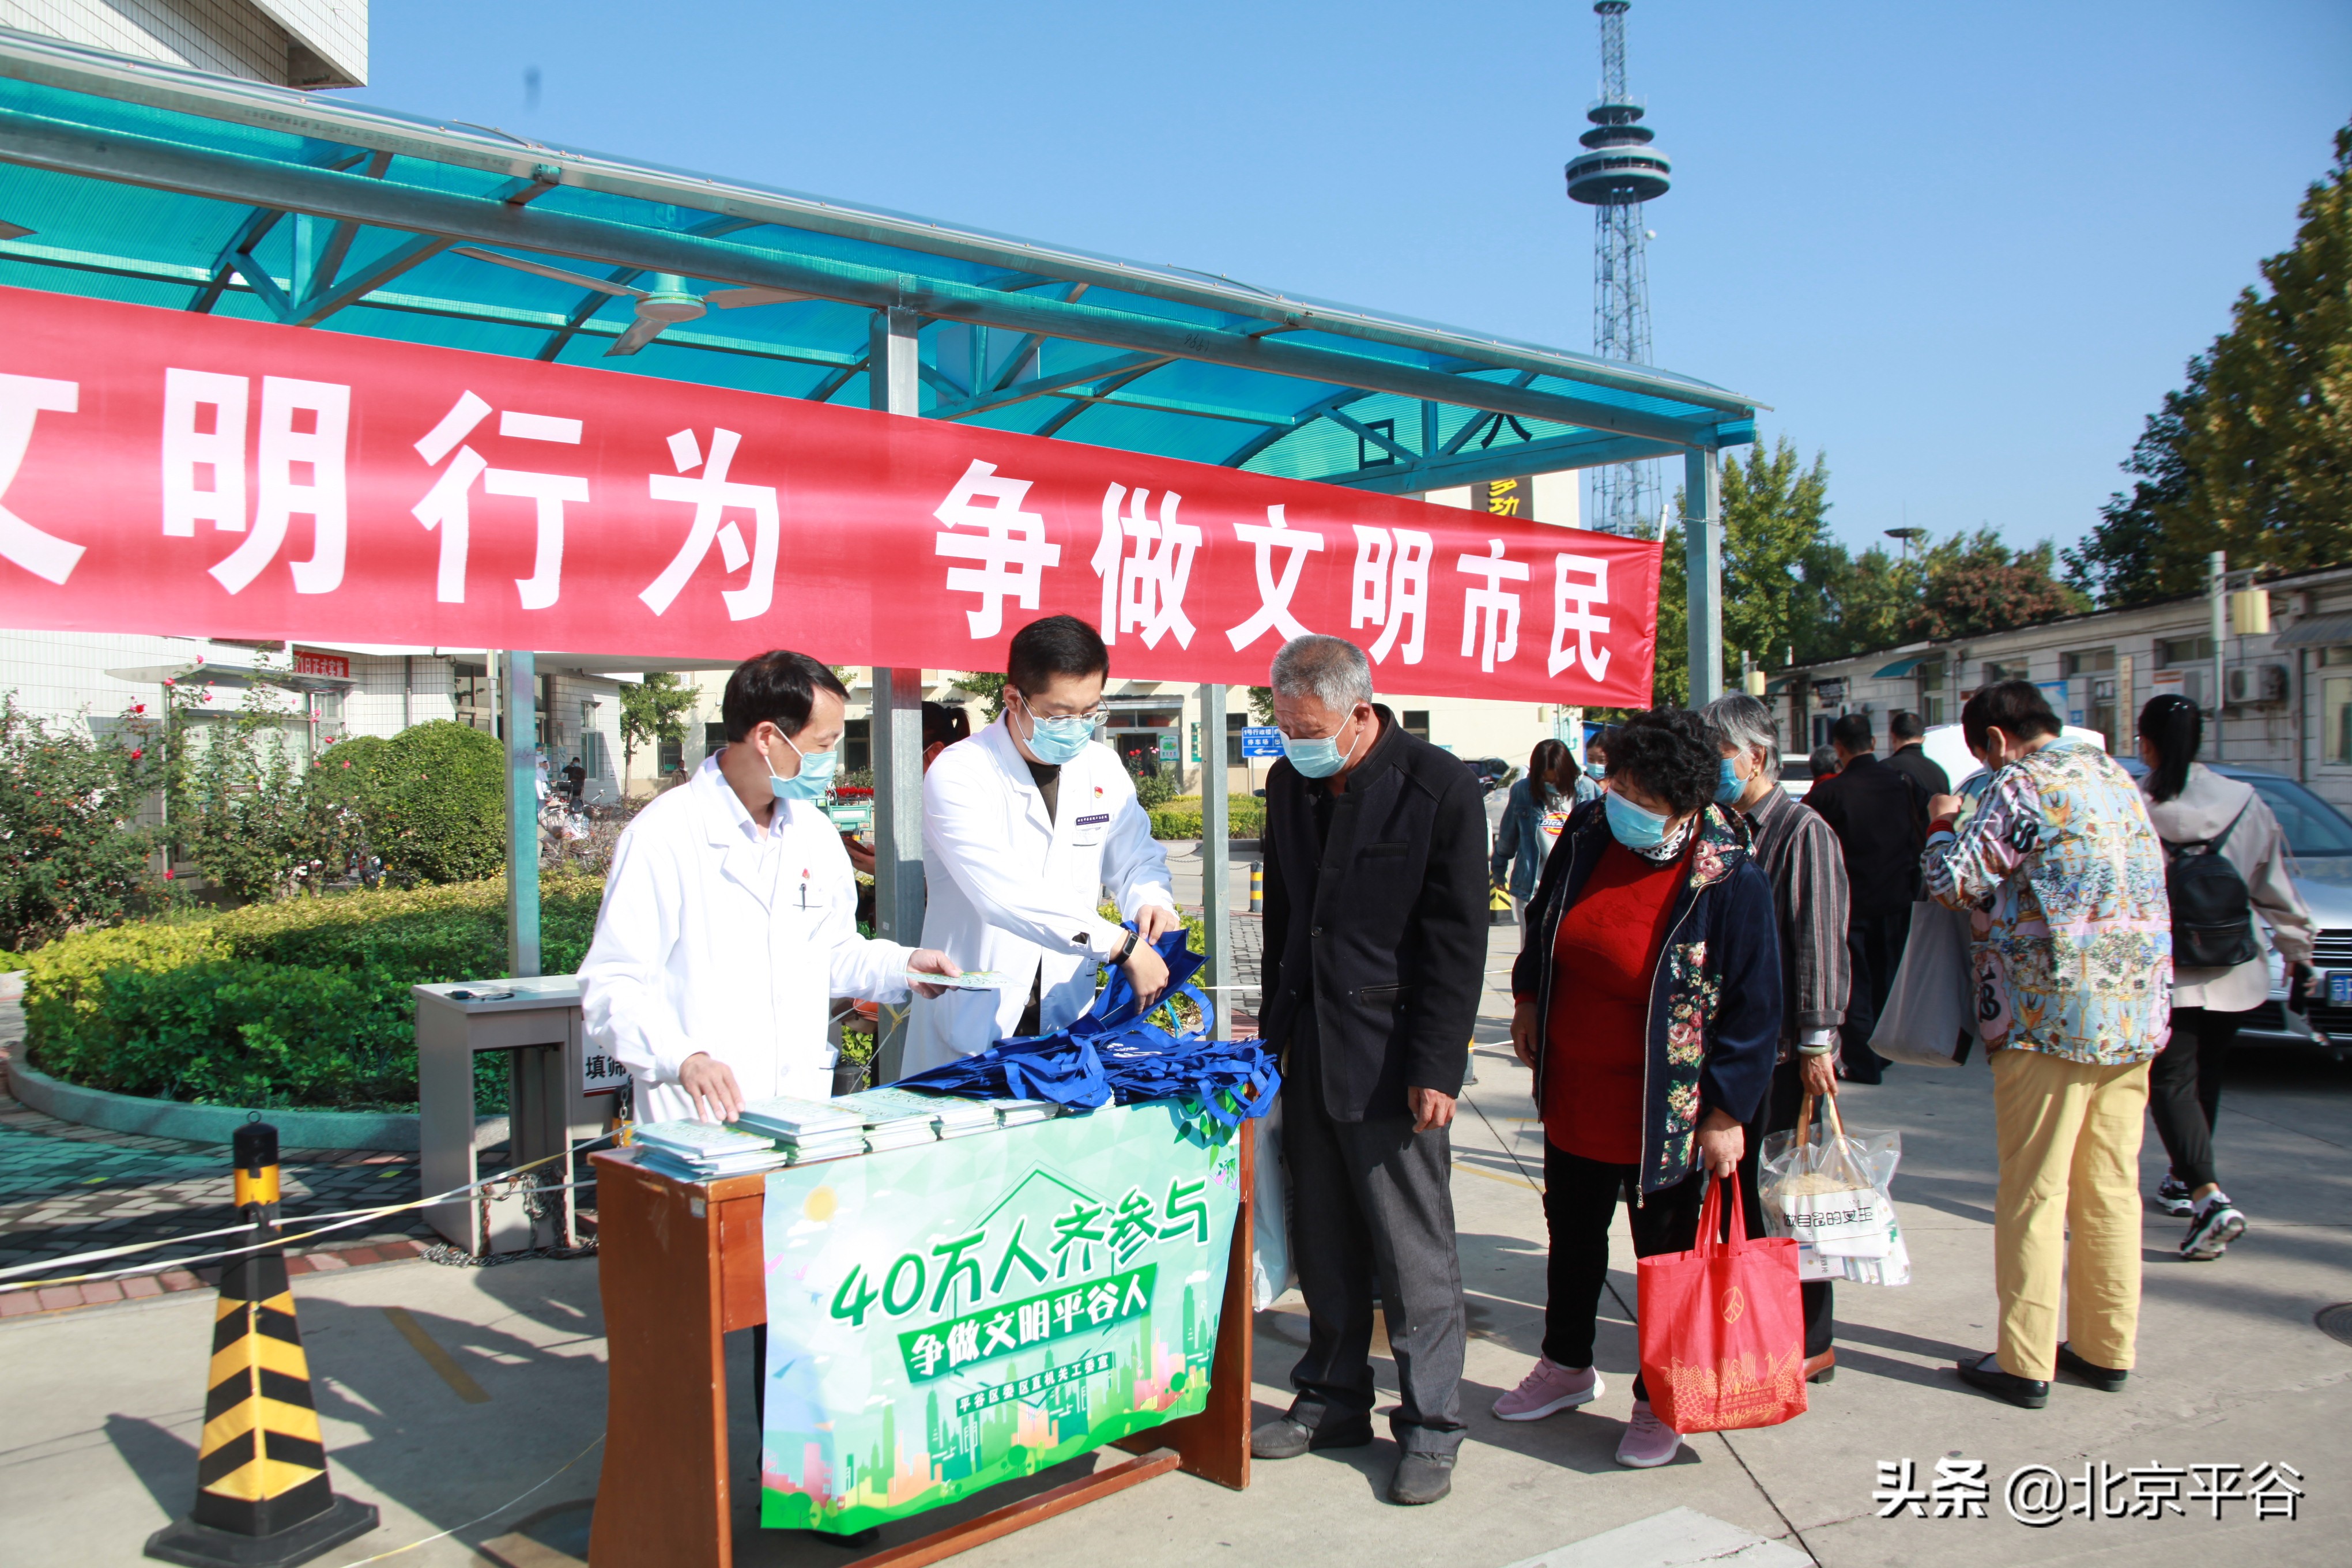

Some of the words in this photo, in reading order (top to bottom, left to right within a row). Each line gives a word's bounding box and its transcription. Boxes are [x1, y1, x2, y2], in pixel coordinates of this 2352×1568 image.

[933, 458, 1612, 682] 争做文明市民
[830, 1178, 1209, 1327] 40万人齐参与
[1784, 1207, 1873, 1227] 做自己的女王
[910, 1274, 1147, 1376] 争做文明平谷人
[959, 1354, 1110, 1413] 平谷区委区直机关工委宣
